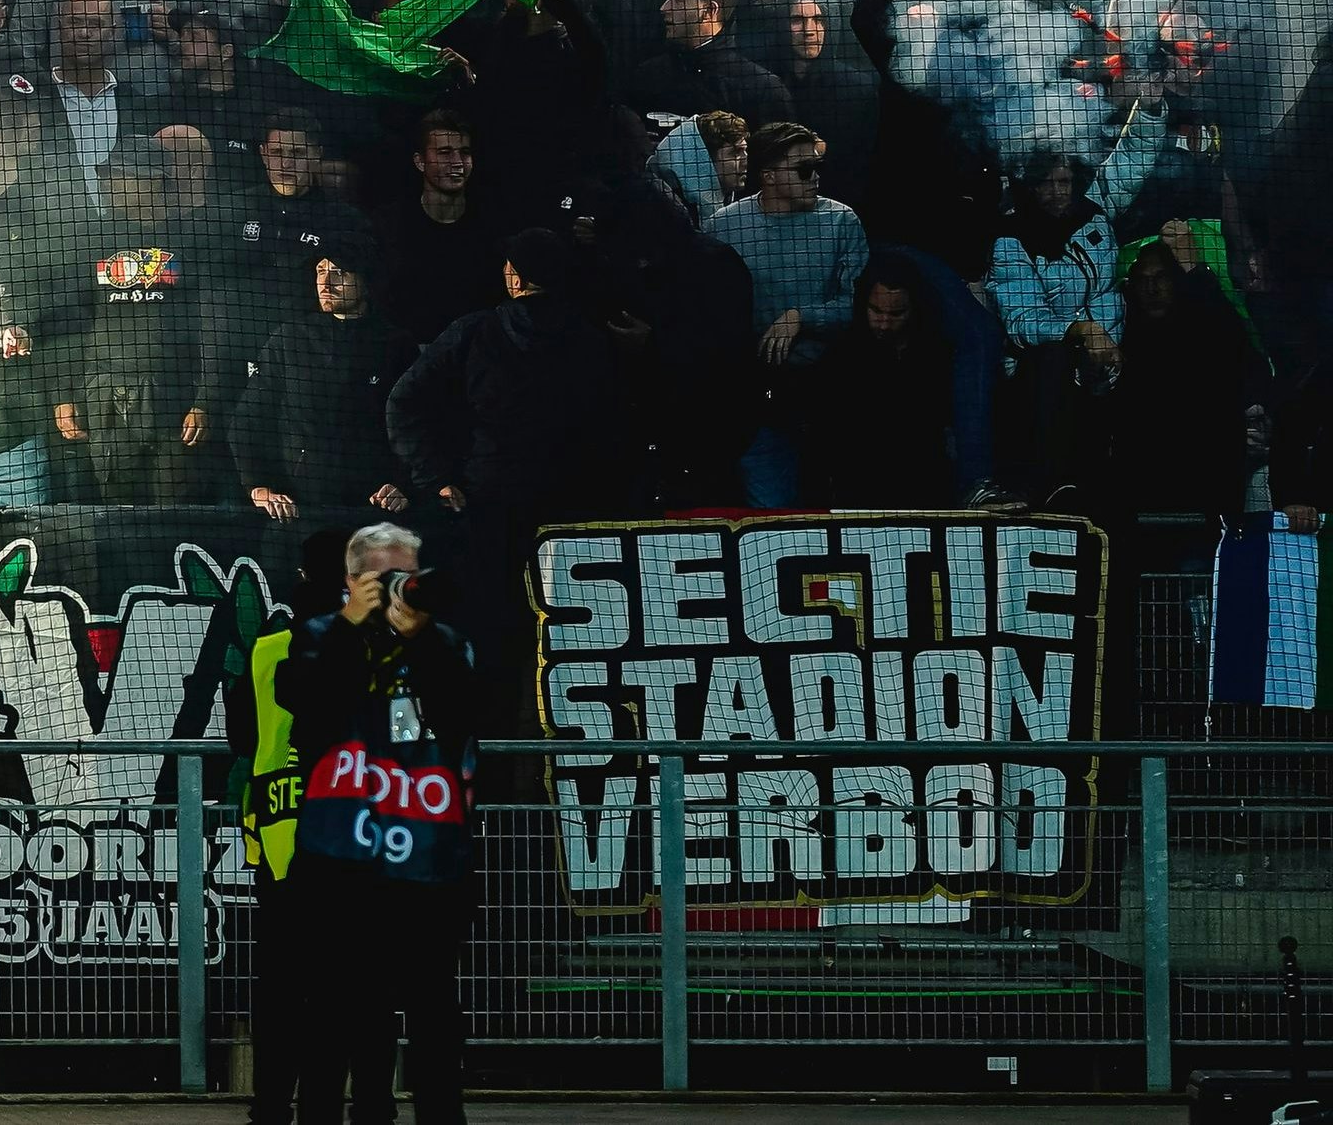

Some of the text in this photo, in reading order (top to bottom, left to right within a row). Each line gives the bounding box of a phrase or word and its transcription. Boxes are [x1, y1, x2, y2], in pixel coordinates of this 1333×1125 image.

[537, 526, 1078, 650] SECTIE
[548, 646, 1075, 767] STADION
[556, 762, 1067, 890] VERBOD
